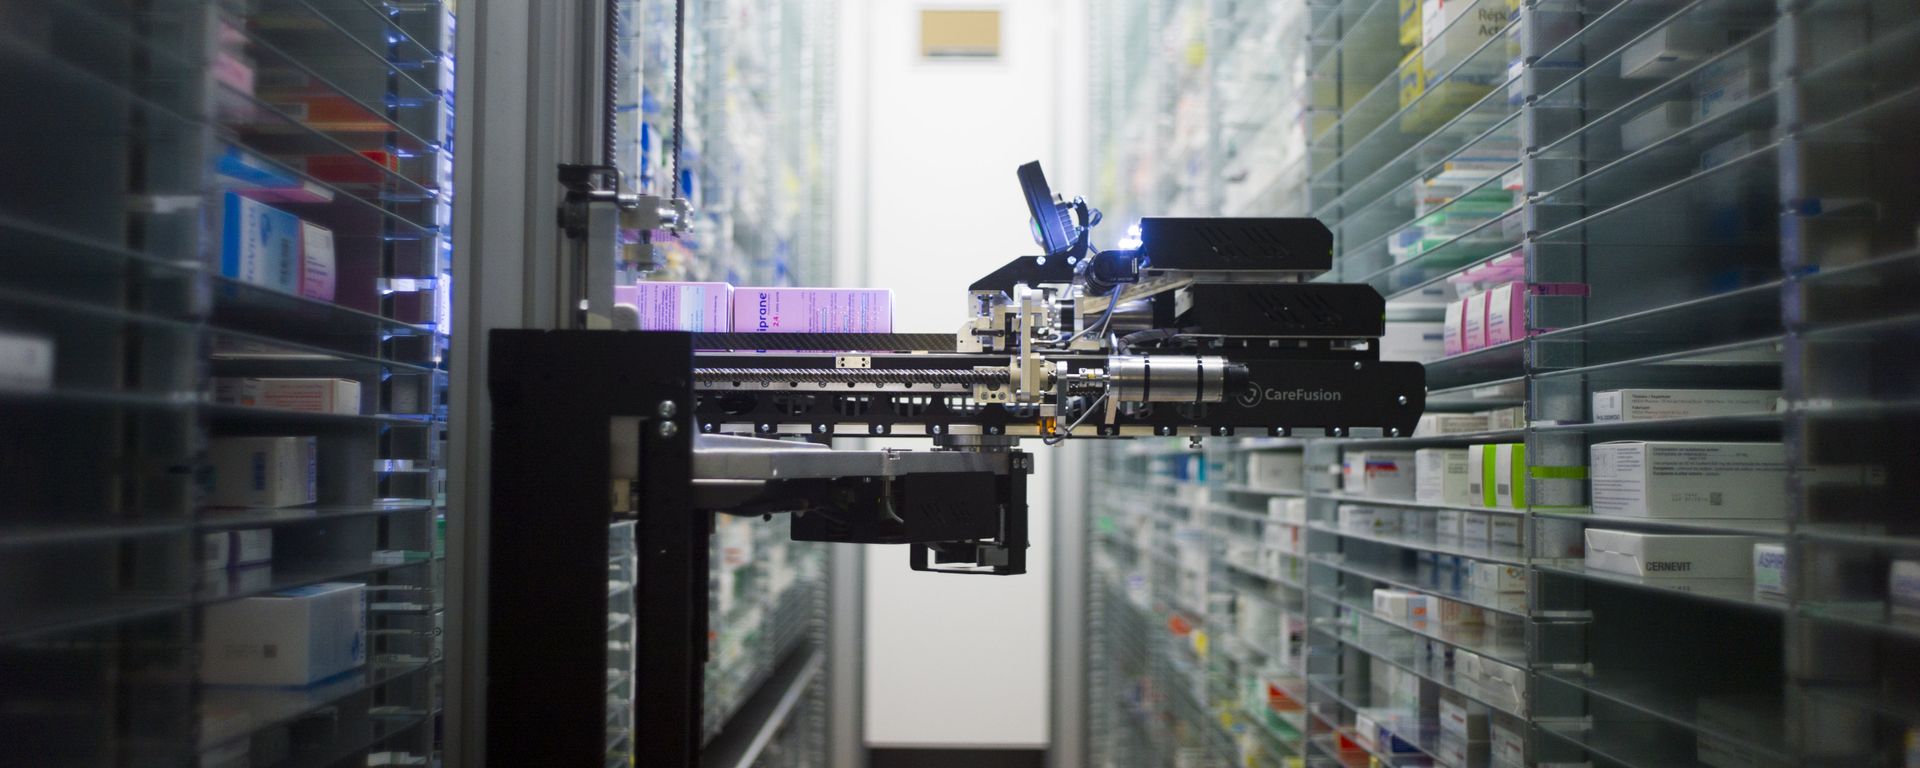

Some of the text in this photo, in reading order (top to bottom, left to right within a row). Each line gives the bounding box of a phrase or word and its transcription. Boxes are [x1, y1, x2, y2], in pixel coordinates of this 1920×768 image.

[756, 292, 769, 353] iprane
[1264, 388, 1342, 401] CareFusion
[1646, 561, 1692, 571] CERNEVIT
